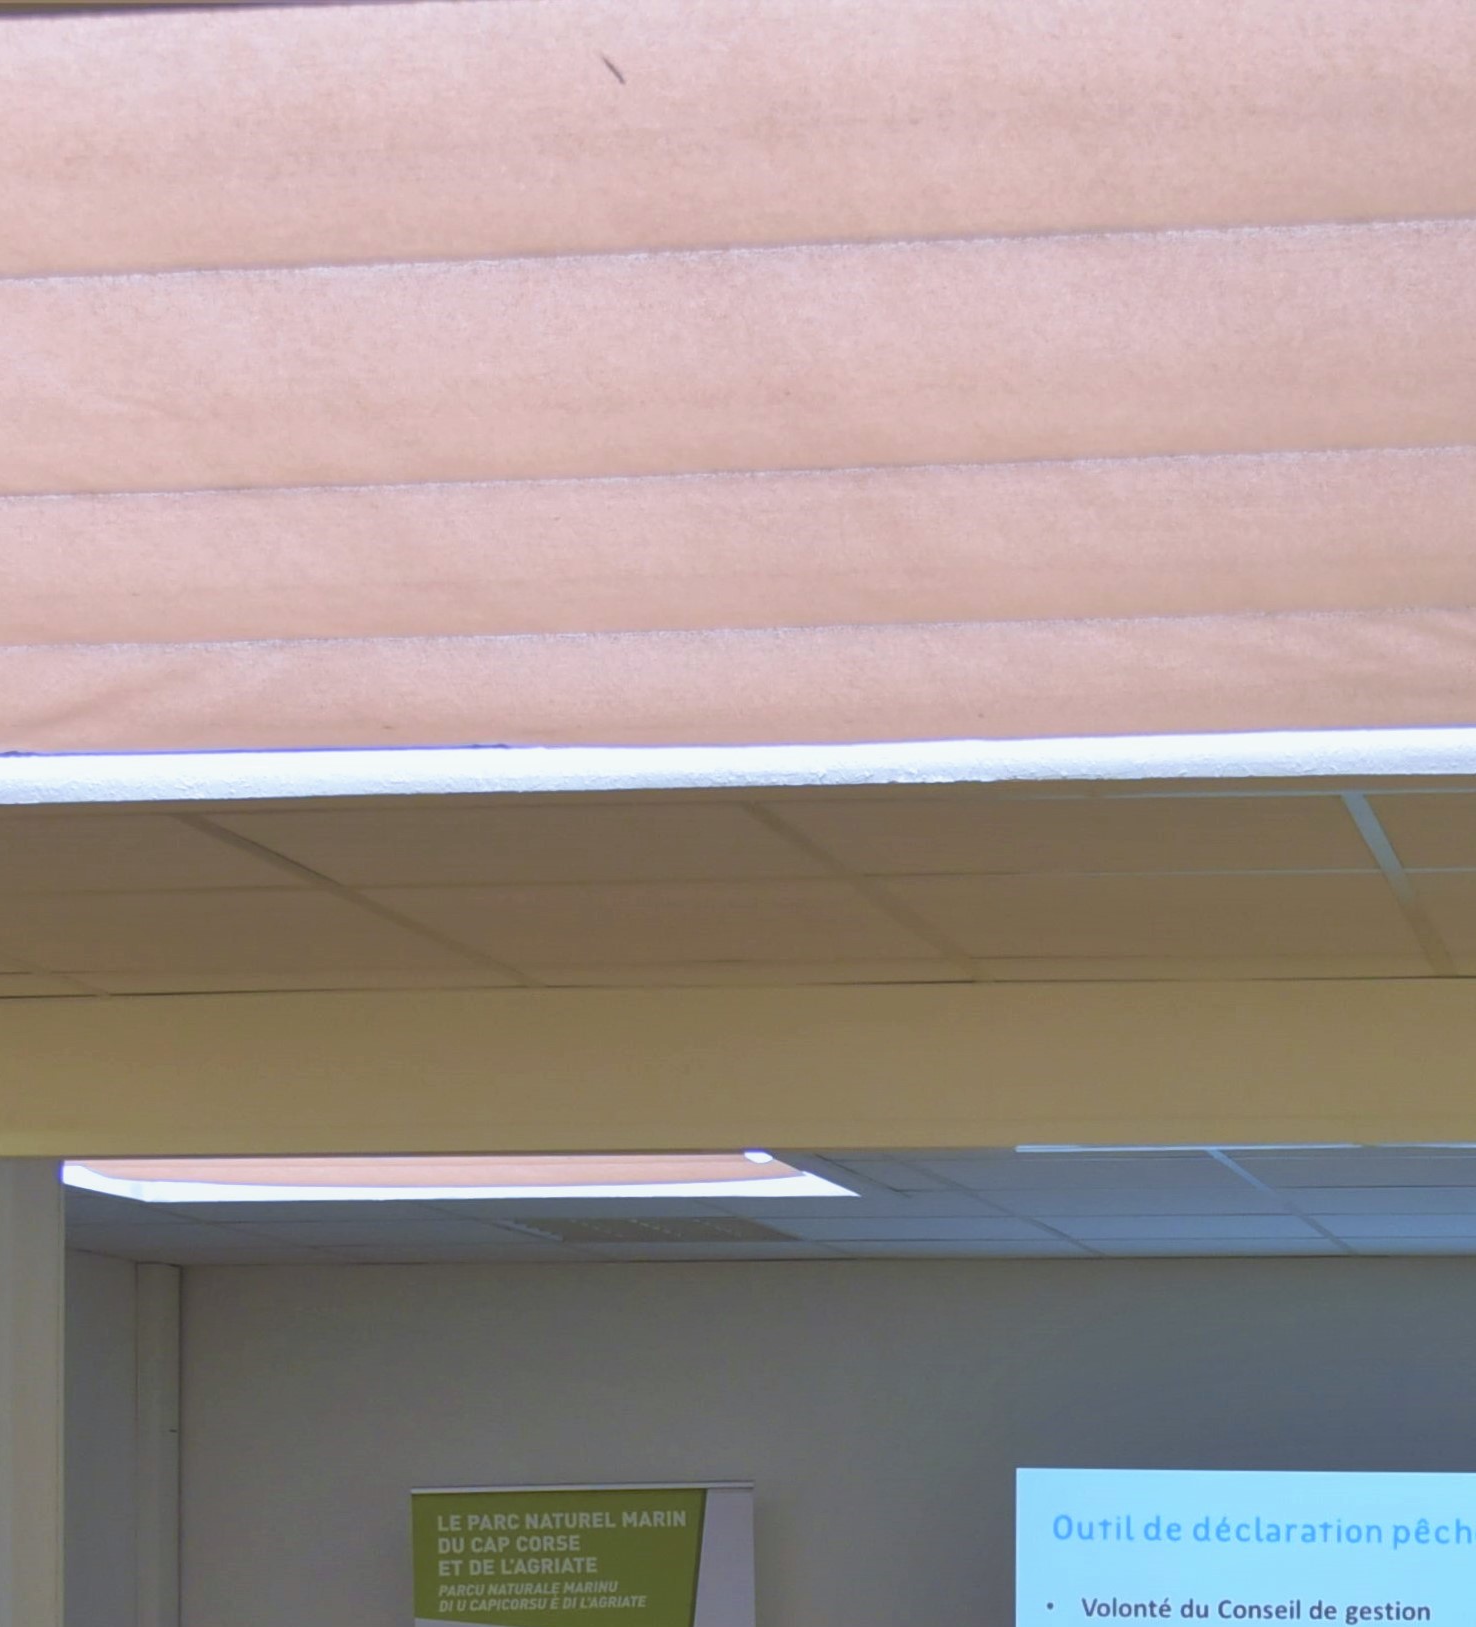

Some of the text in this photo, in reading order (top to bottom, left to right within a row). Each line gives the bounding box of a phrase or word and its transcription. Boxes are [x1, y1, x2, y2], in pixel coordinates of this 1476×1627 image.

[438, 1511, 686, 1531] LE PARC NATUREL MARIN
[1052, 1514, 1135, 1542] Outil
[1143, 1515, 1182, 1542] de
[1192, 1516, 1382, 1544] déclaration
[438, 1535, 580, 1554] DU CAP CORSE
[438, 1559, 463, 1576] ET
[469, 1559, 494, 1576] DE
[439, 1581, 618, 1596] PARCU NATURALE MARINU
[439, 1600, 454, 1612] DI
[456, 1600, 467, 1611] U
[469, 1598, 548, 1611] CAPICORSU
[562, 1597, 577, 1609] DI
[1081, 1597, 1431, 1626] Volonté du Conseil de gestion
